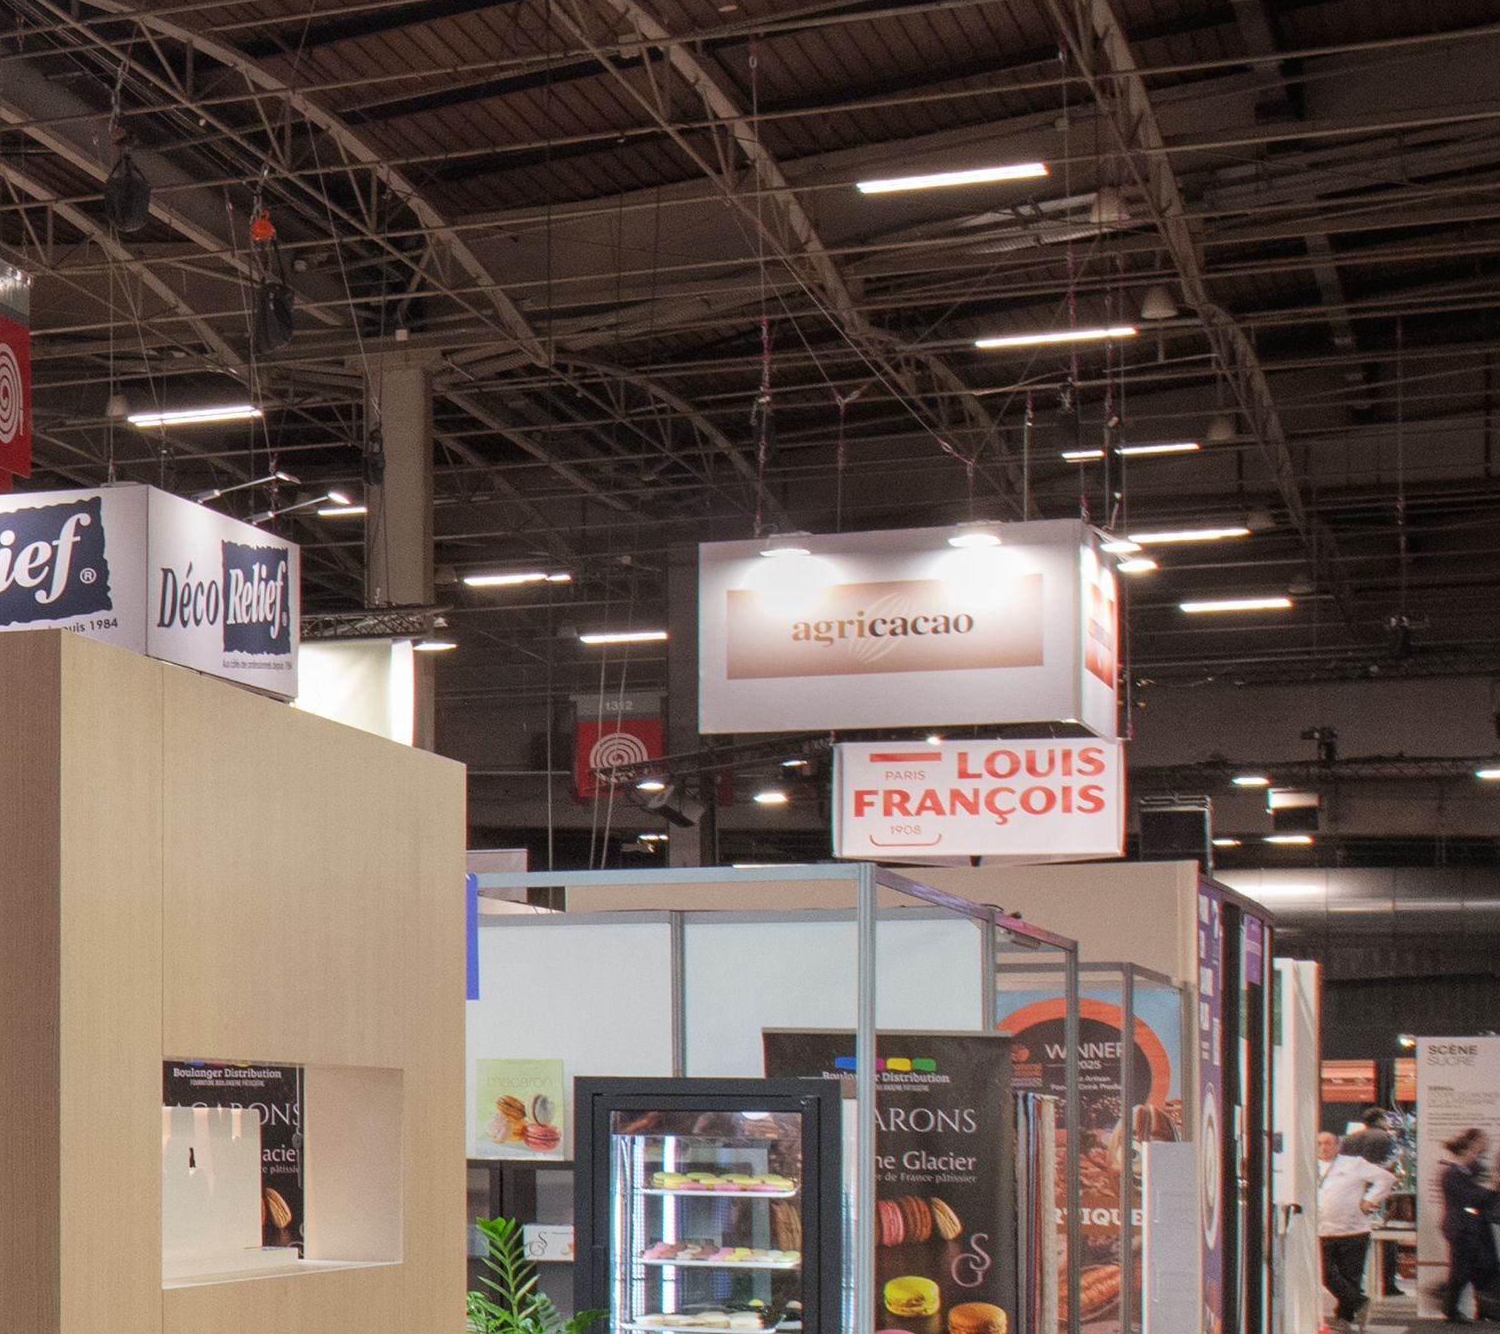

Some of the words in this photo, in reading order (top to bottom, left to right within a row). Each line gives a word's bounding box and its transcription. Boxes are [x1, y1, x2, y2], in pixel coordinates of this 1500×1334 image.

[157, 561, 219, 628] Déco
[226, 561, 286, 639] Relief
[90, 618, 118, 630] 1984
[792, 611, 973, 648] agricacao
[957, 747, 1105, 780] LOUIS
[885, 769, 925, 781] PARIS
[854, 784, 1104, 825] FRANÇOIS
[890, 824, 921, 836] 1908
[173, 1067, 223, 1079] Boulanger
[224, 1068, 282, 1079] Distribution
[882, 1072, 950, 1083] Distribution
[874, 1108, 977, 1133] ARONS
[263, 1147, 299, 1162] acie
[903, 1149, 977, 1171] Glacier
